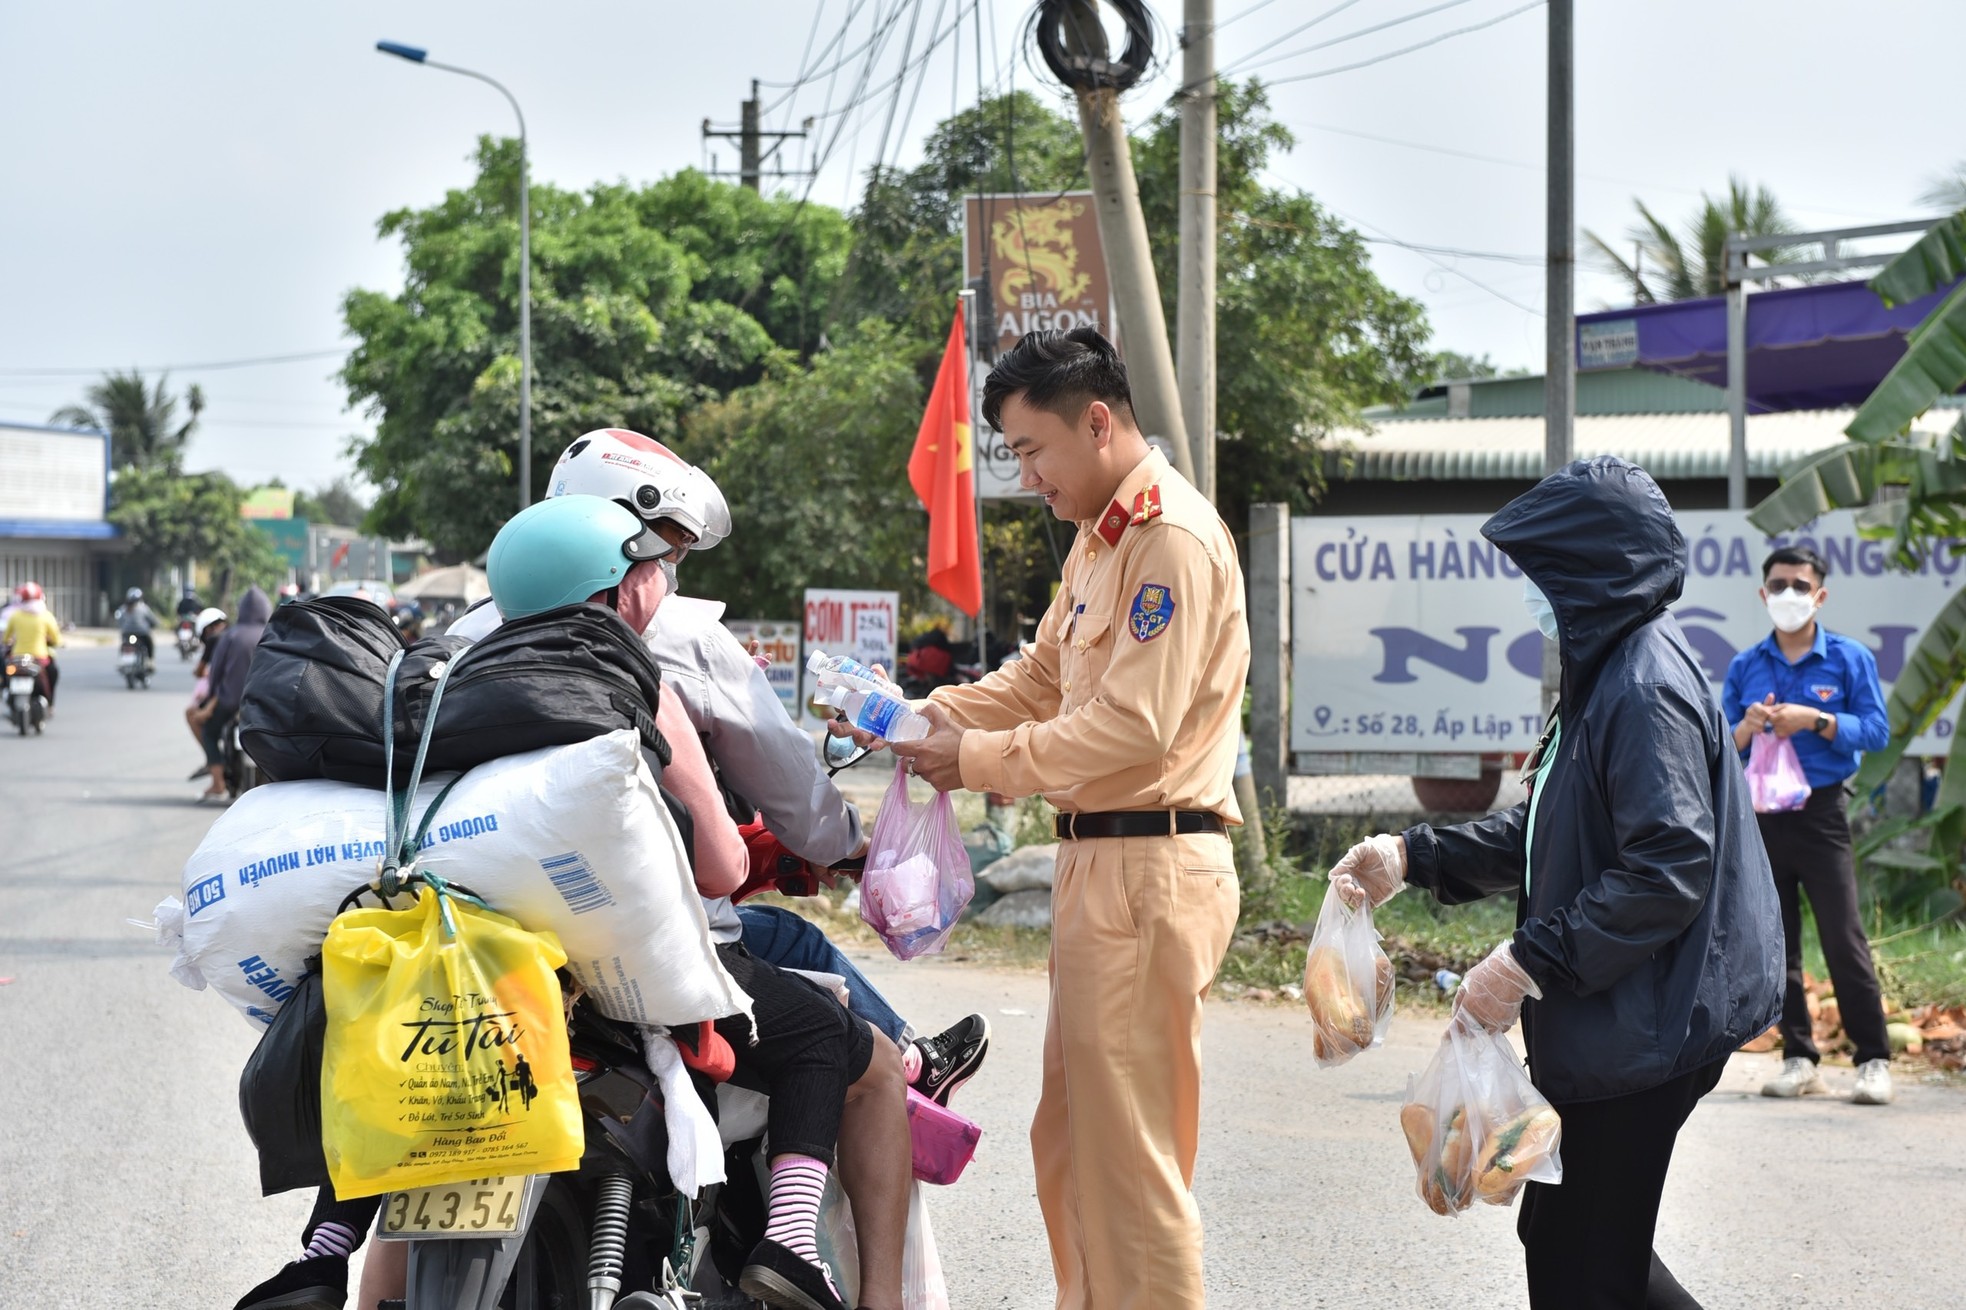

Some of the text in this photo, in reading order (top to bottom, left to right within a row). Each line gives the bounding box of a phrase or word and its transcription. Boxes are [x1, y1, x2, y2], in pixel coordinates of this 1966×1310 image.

[1020, 293, 1058, 309] BIA
[996, 309, 1099, 337] AIGON
[1315, 527, 1396, 581] CỬA
[805, 600, 844, 642] CƠM
[1133, 612, 1164, 624] CS GT
[1356, 711, 1384, 735] Số
[1391, 715, 1424, 738] 28,
[1433, 706, 1464, 740] Ấp
[1472, 715, 1513, 740] Lập
[438, 813, 499, 842] ĐƯỜNG
[305, 844, 338, 867] HẠT
[342, 839, 387, 862] UYỆN
[238, 850, 301, 889] NHUYỄN
[188, 878, 223, 914] 50 KG
[238, 955, 296, 1003] UYỆN
[419, 996, 453, 1016] Shop
[400, 1011, 526, 1063] Tú Tài
[440, 1077, 461, 1089] Nam,
[483, 1073, 495, 1084] Em
[468, 1110, 485, 1120] Sinh
[432, 1137, 462, 1147] Hàng
[465, 1135, 486, 1145] Bao
[387, 1190, 515, 1231] 343.54
